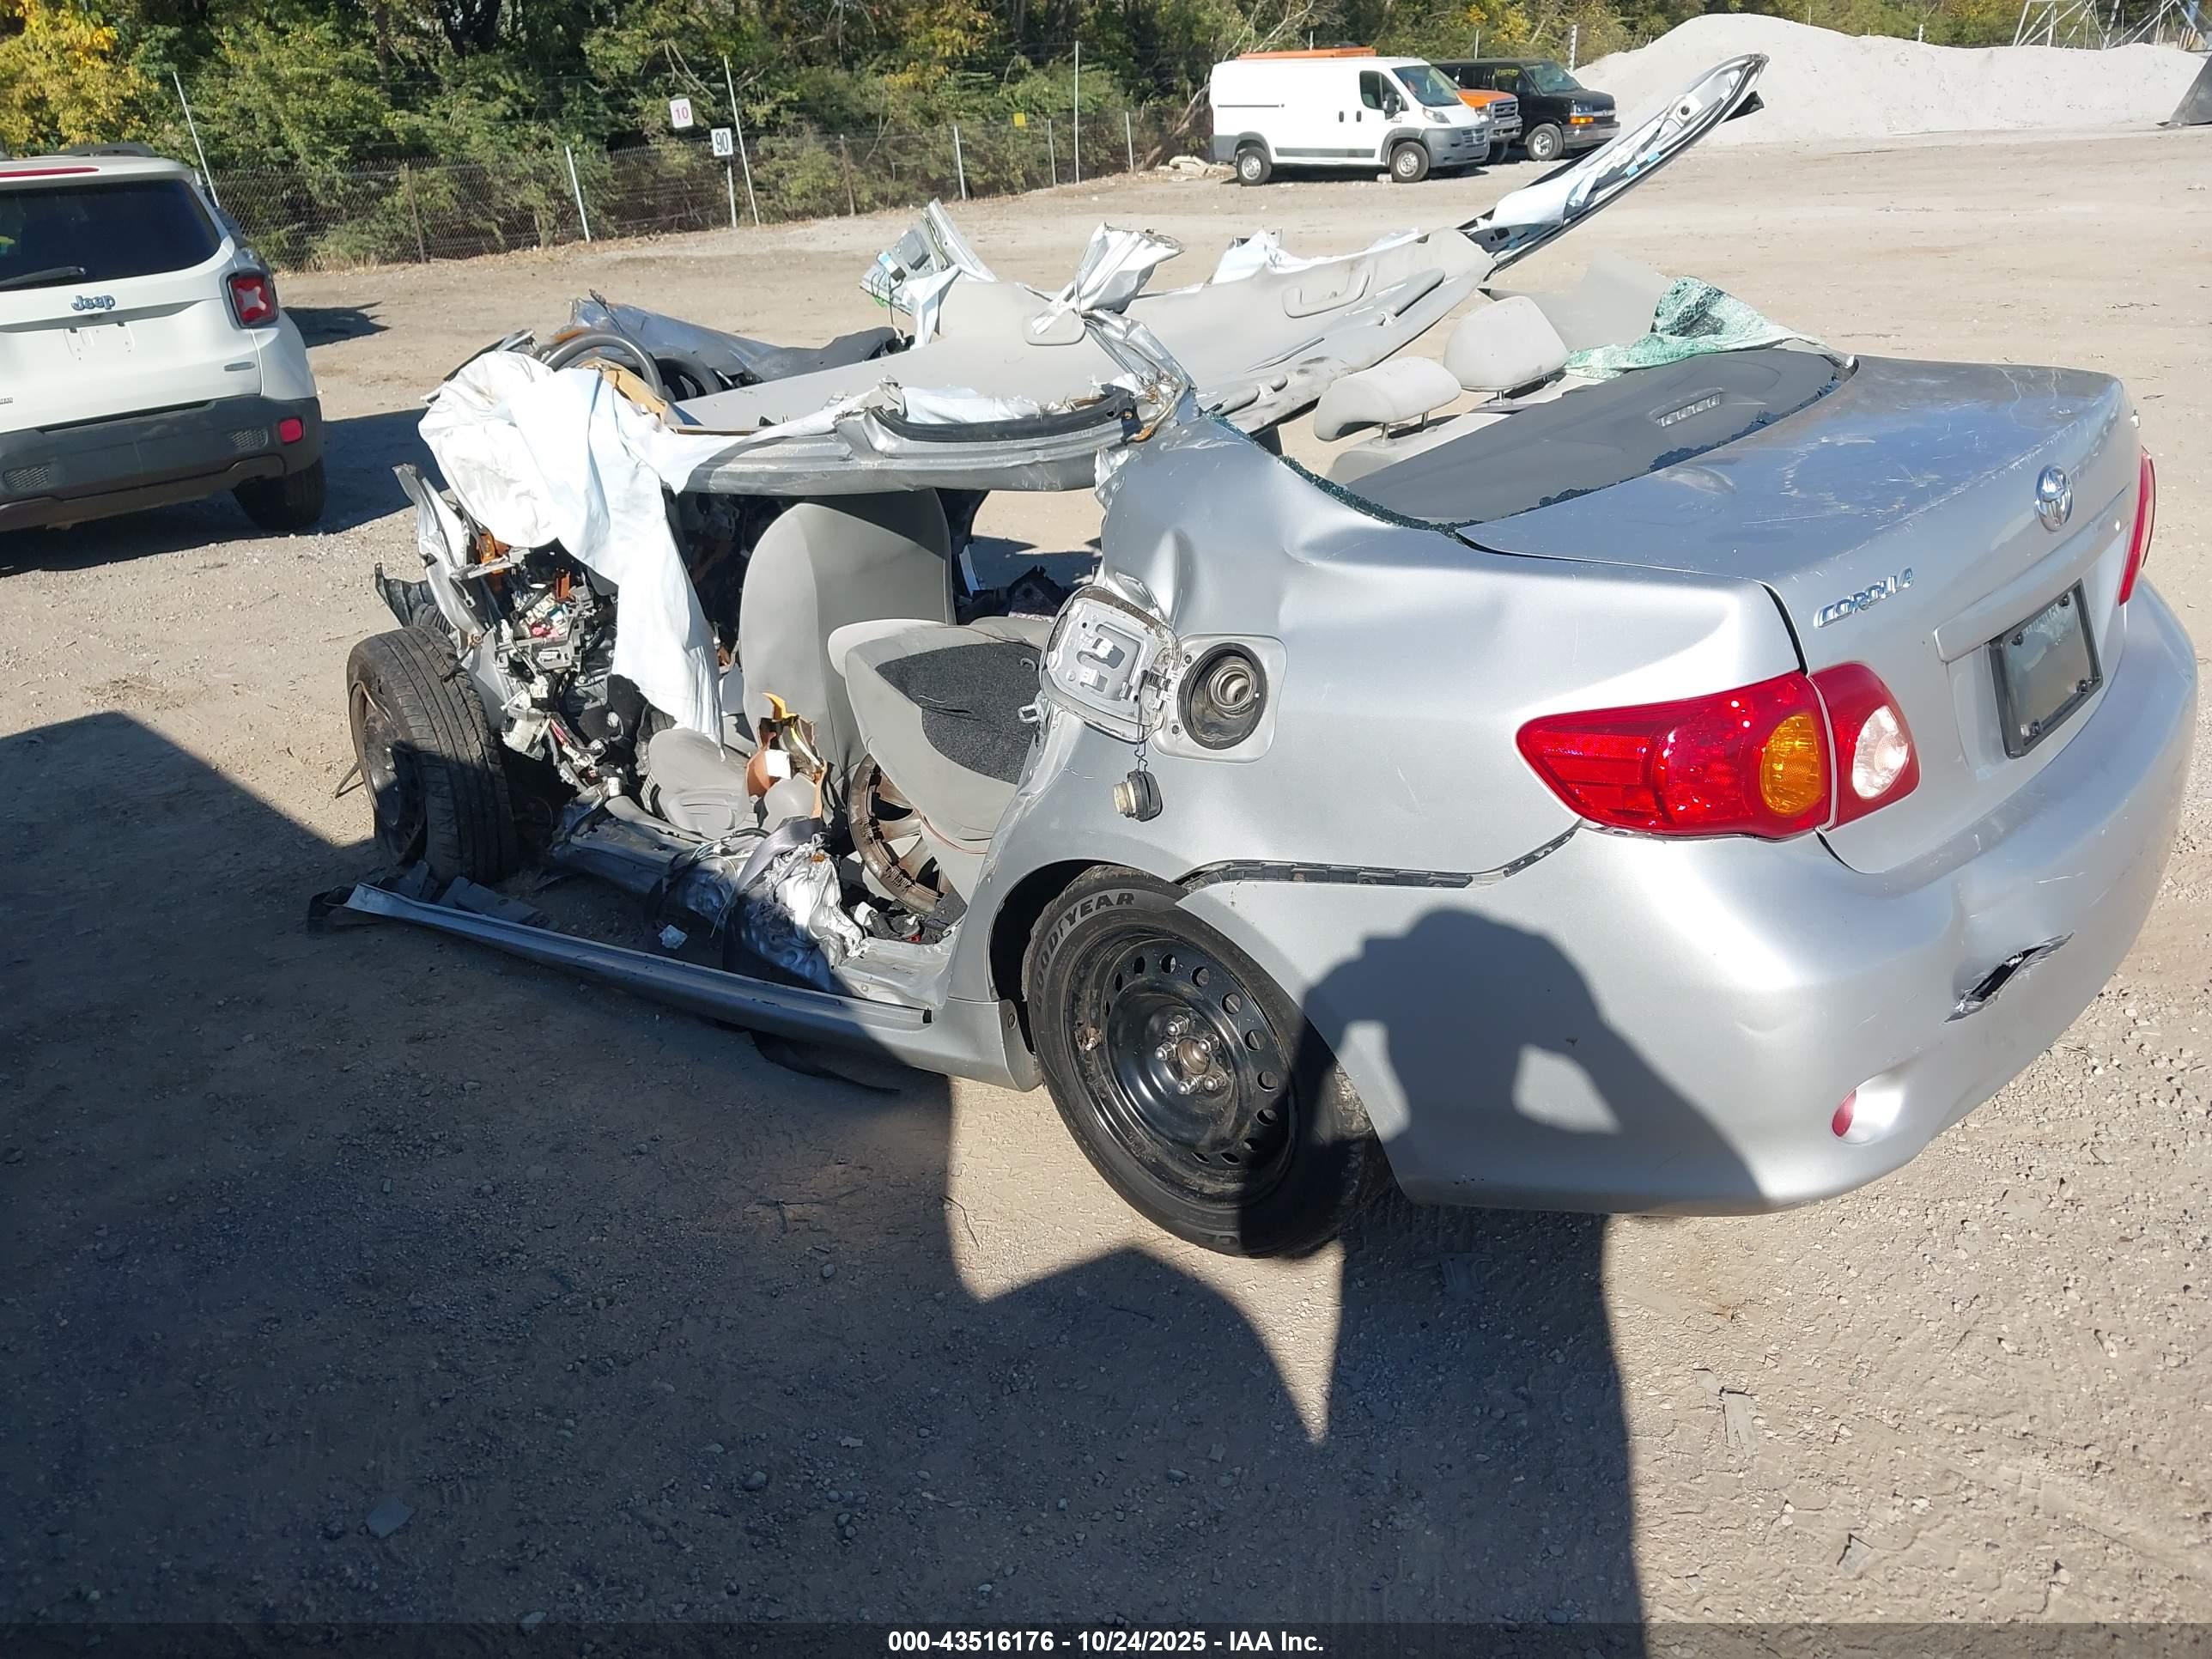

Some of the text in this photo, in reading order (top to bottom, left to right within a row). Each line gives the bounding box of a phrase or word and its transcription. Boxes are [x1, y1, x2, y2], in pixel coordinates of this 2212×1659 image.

[675, 106, 689, 119] 10
[715, 131, 729, 153] 90
[70, 295, 116, 311] Jeep
[1813, 567, 1913, 628] COROLLA
[1035, 892, 1134, 1012] GOODYEAR
